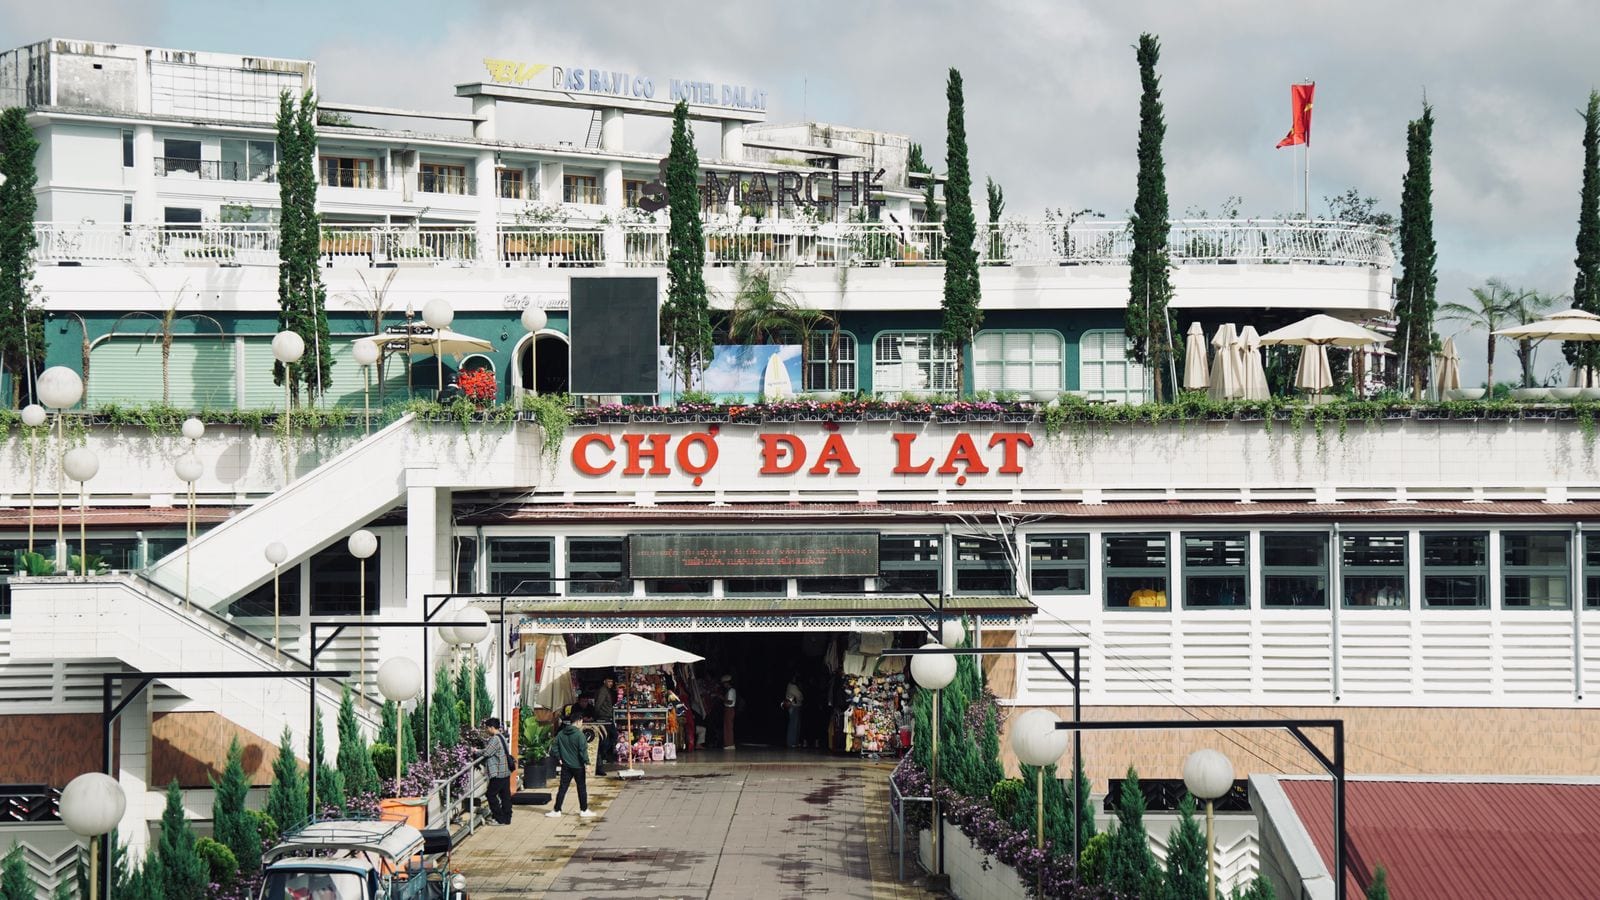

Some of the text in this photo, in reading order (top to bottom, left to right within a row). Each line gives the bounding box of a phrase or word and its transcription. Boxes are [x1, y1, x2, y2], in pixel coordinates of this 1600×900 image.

[552, 66, 585, 91] DAS
[669, 79, 718, 105] HOTEL
[721, 84, 768, 110] DALAT
[705, 168, 886, 207] MARCHÉ
[571, 421, 1034, 486] CHỢ ĐÀ LẠT
